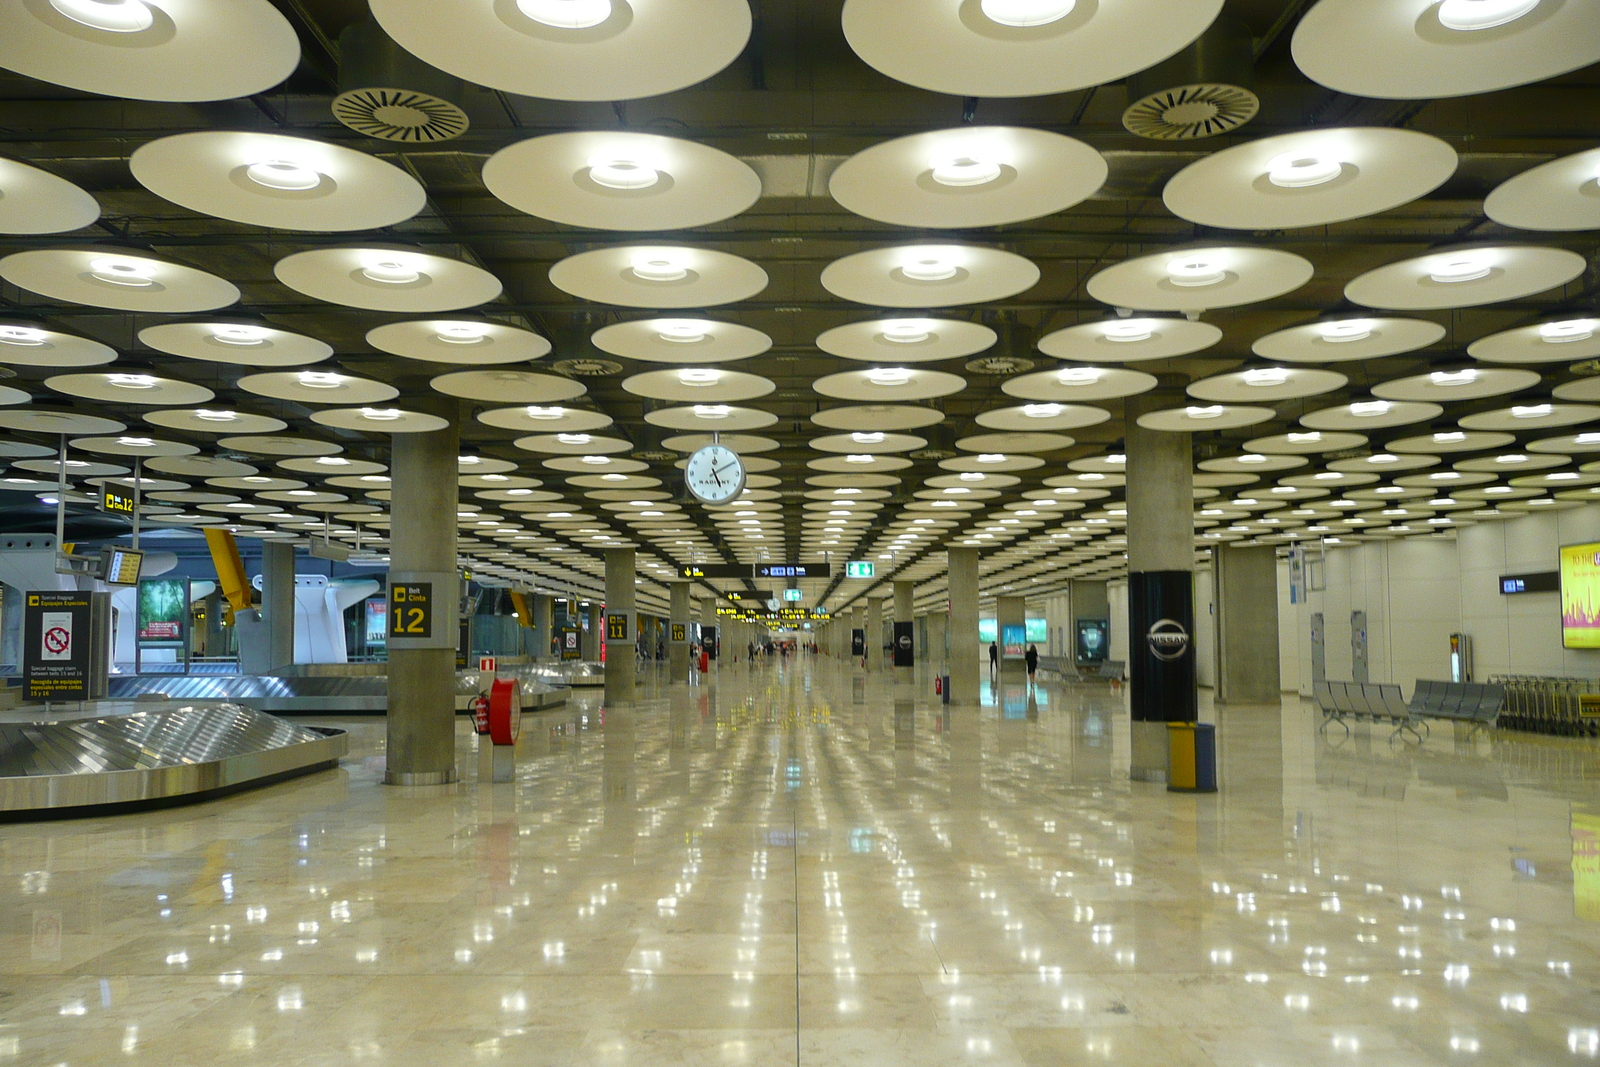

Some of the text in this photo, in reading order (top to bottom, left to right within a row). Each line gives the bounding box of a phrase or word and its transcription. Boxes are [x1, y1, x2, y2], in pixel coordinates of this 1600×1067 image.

[124, 498, 133, 512] 12
[394, 608, 424, 633] 12
[610, 626, 623, 638] 11
[674, 632, 683, 640] 10
